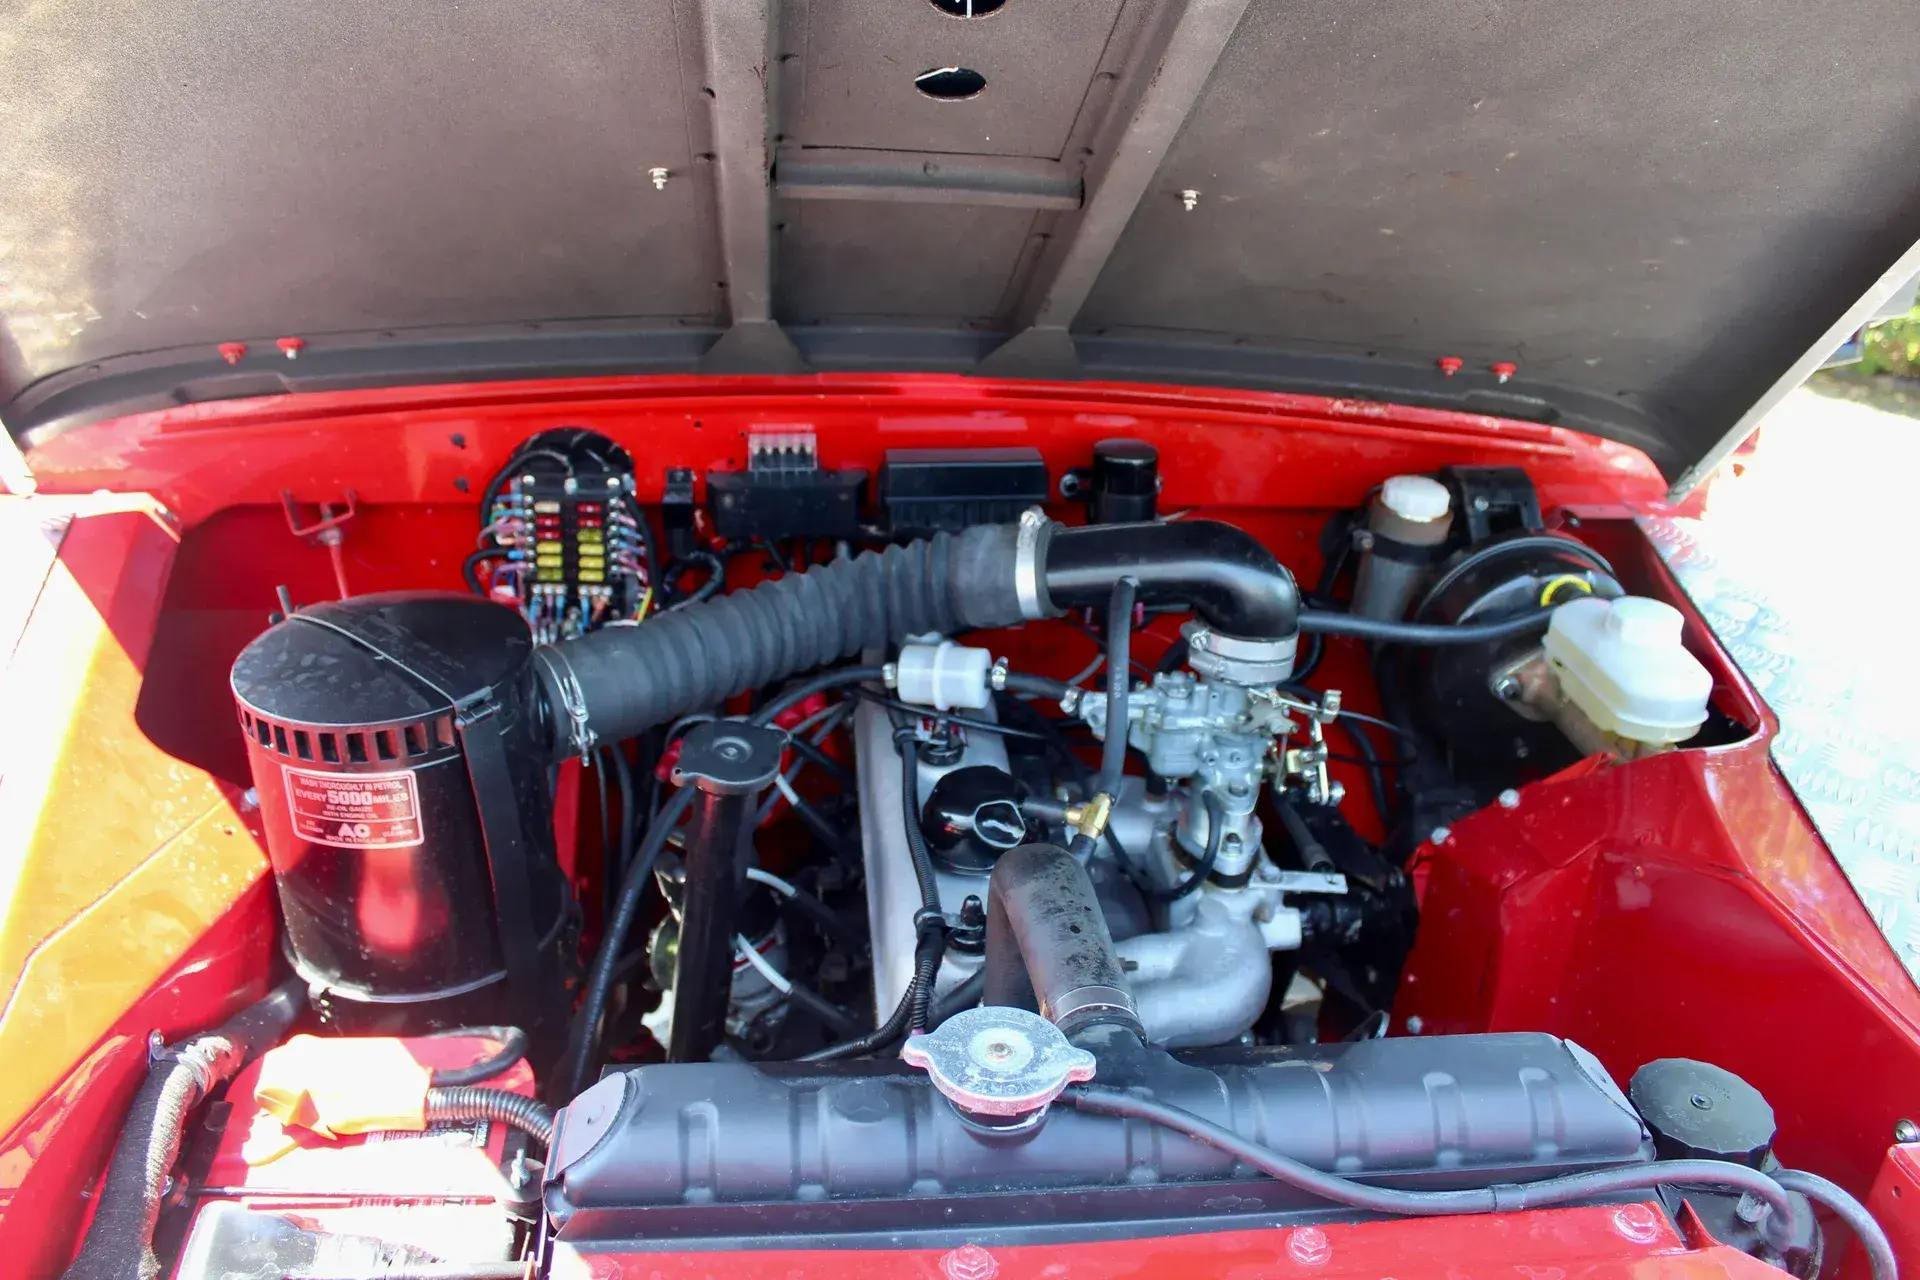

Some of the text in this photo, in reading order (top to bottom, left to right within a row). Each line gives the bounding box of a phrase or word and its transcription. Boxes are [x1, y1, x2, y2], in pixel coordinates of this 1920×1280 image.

[318, 780, 366, 791] THOROUGHLY
[365, 783, 372, 791] IN
[374, 781, 402, 790] PETROL
[295, 788, 409, 805] EVERY 5000 MILES
